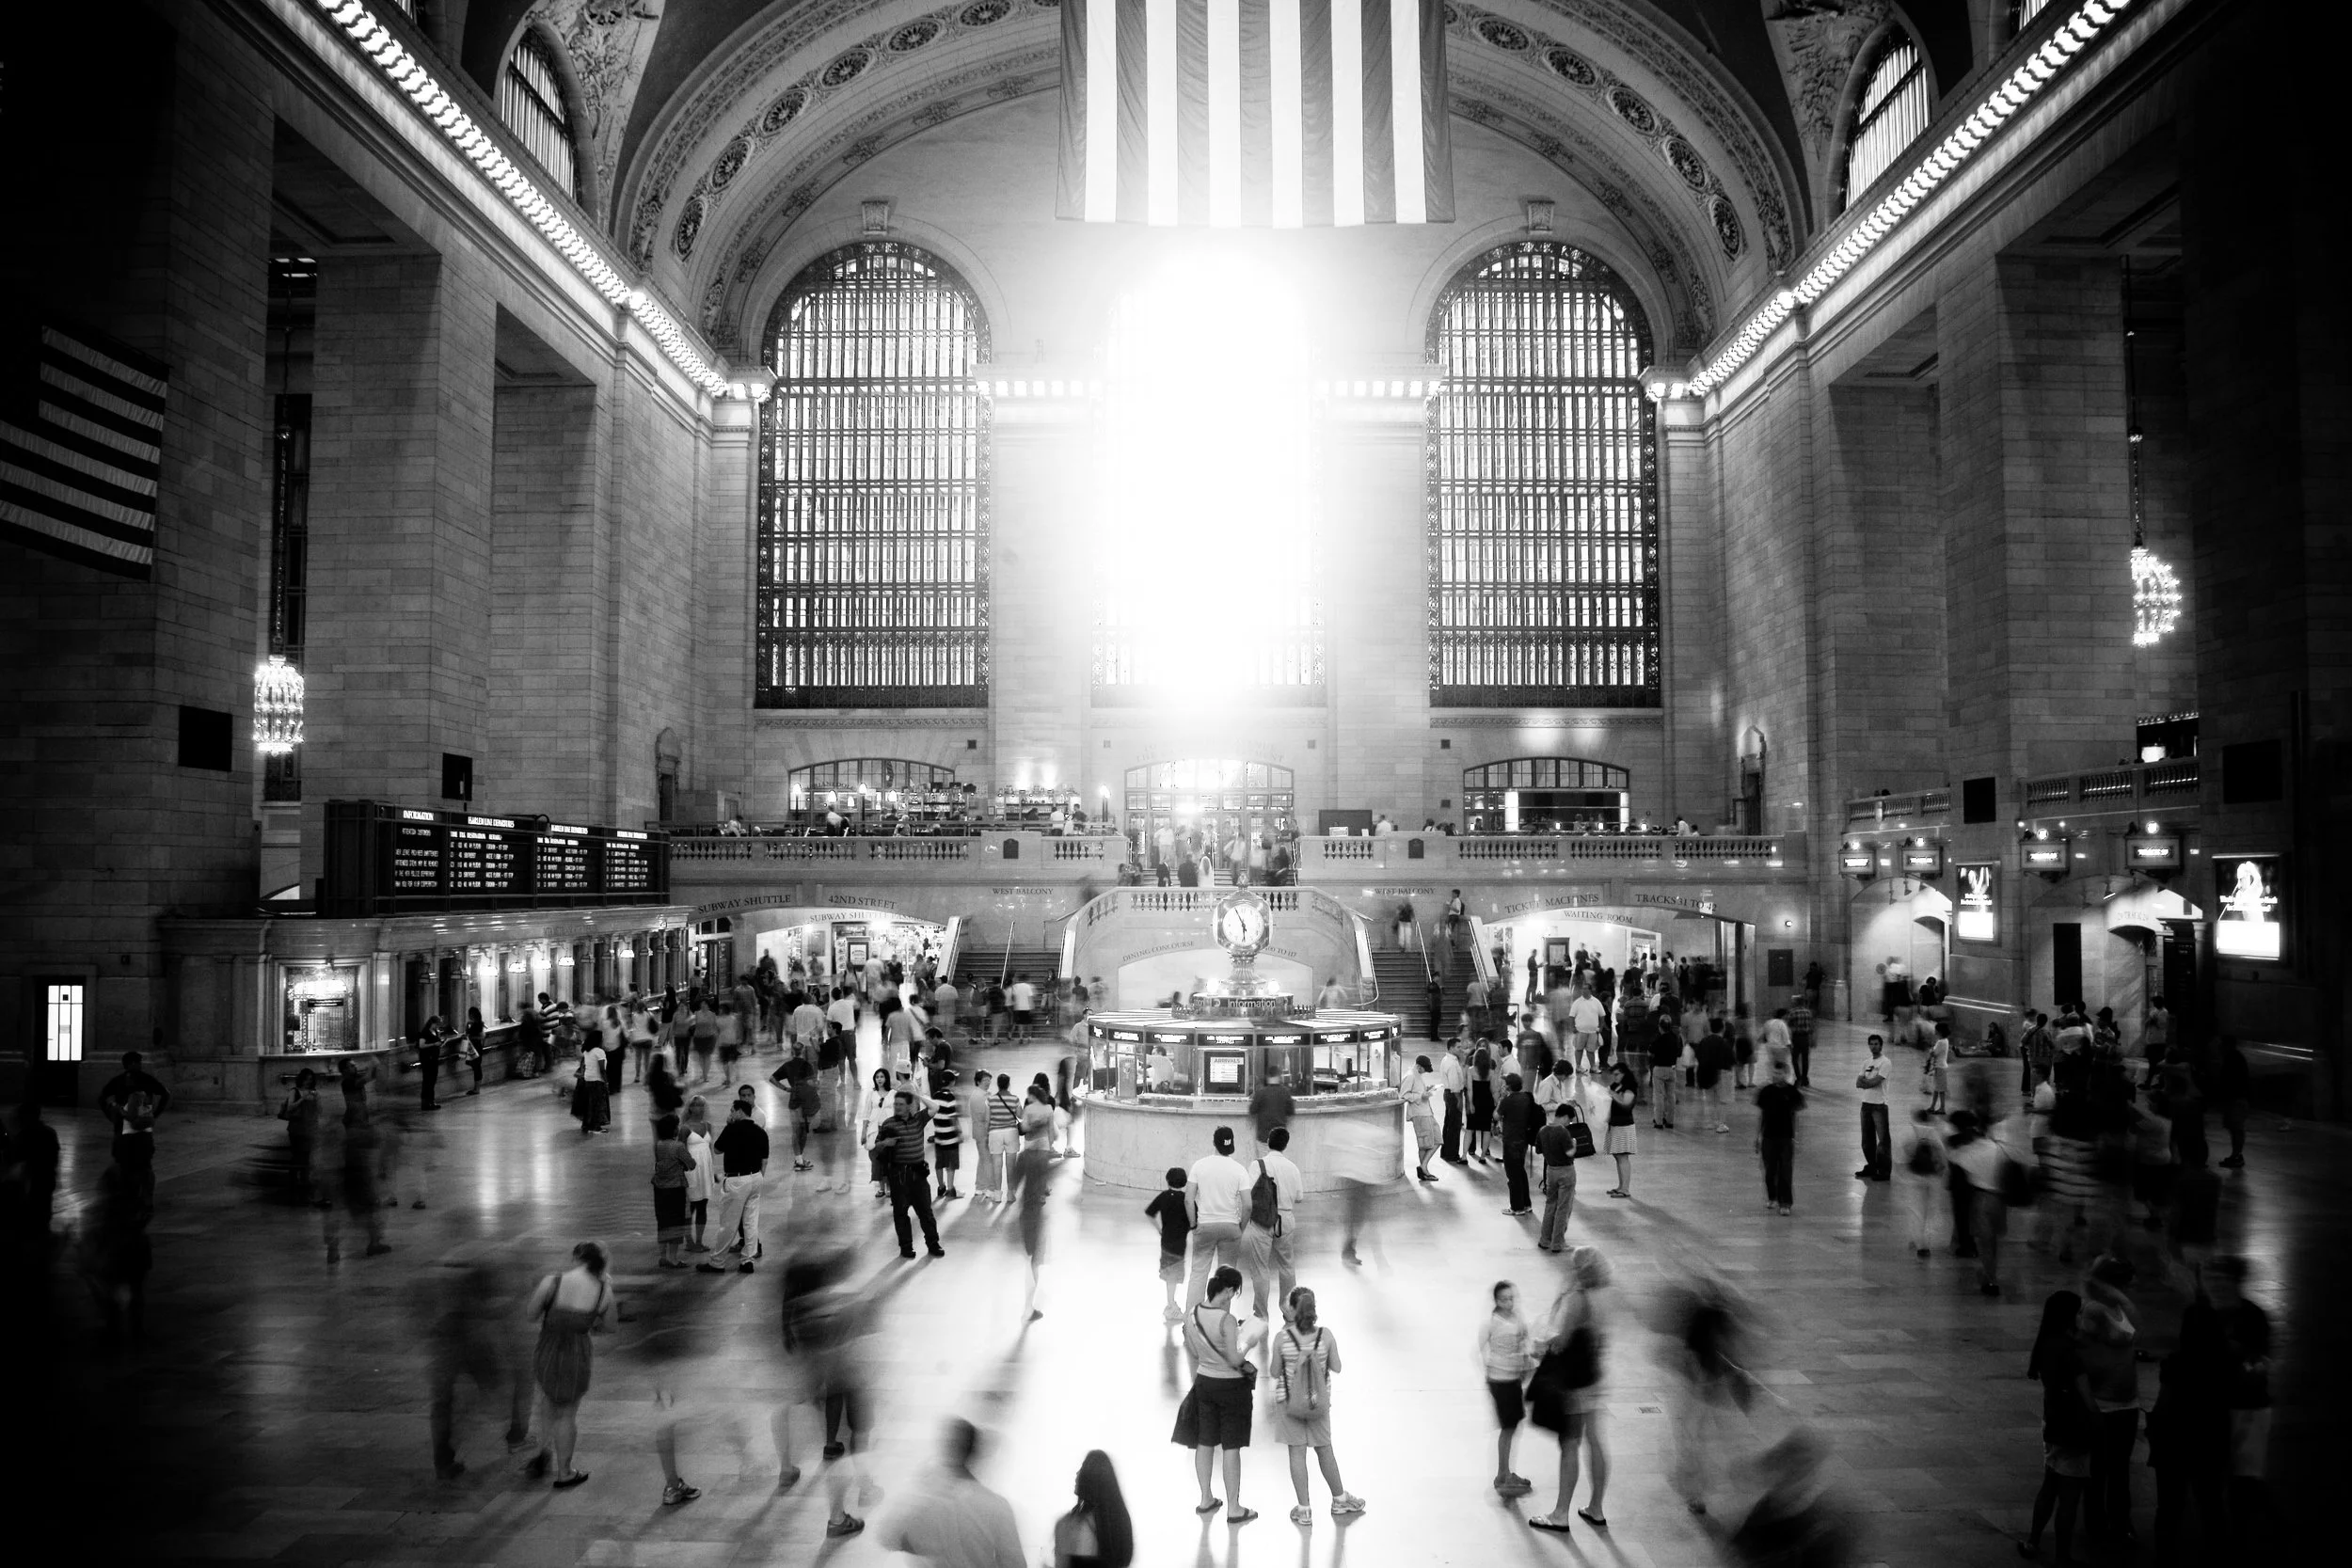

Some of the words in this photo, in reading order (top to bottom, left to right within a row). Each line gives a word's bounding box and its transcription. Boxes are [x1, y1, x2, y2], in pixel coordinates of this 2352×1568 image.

[993, 887, 1014, 895] WEST
[1015, 887, 1055, 895] BALCONY
[1375, 887, 1397, 895] WEST
[1398, 887, 1436, 895] BALCONY
[698, 898, 741, 914] SUBWAY
[743, 894, 792, 907] SHUTTLE
[828, 895, 856, 904] 42ND
[857, 896, 898, 910] STREET
[1504, 899, 1540, 913] TICKET
[1544, 894, 1600, 907] MACHINES
[1634, 894, 1677, 905] TRACKS
[1677, 897, 1688, 907] 31
[1690, 898, 1705, 910] TO
[1707, 902, 1718, 912] 42
[809, 912, 847, 923] SUBWAY
[1564, 910, 1604, 920] WAITING
[1606, 913, 1634, 925] ROOM
[1122, 946, 1152, 962] DINING
[1151, 941, 1195, 954] CONCOURSE
[1227, 997, 1277, 1009] Information
